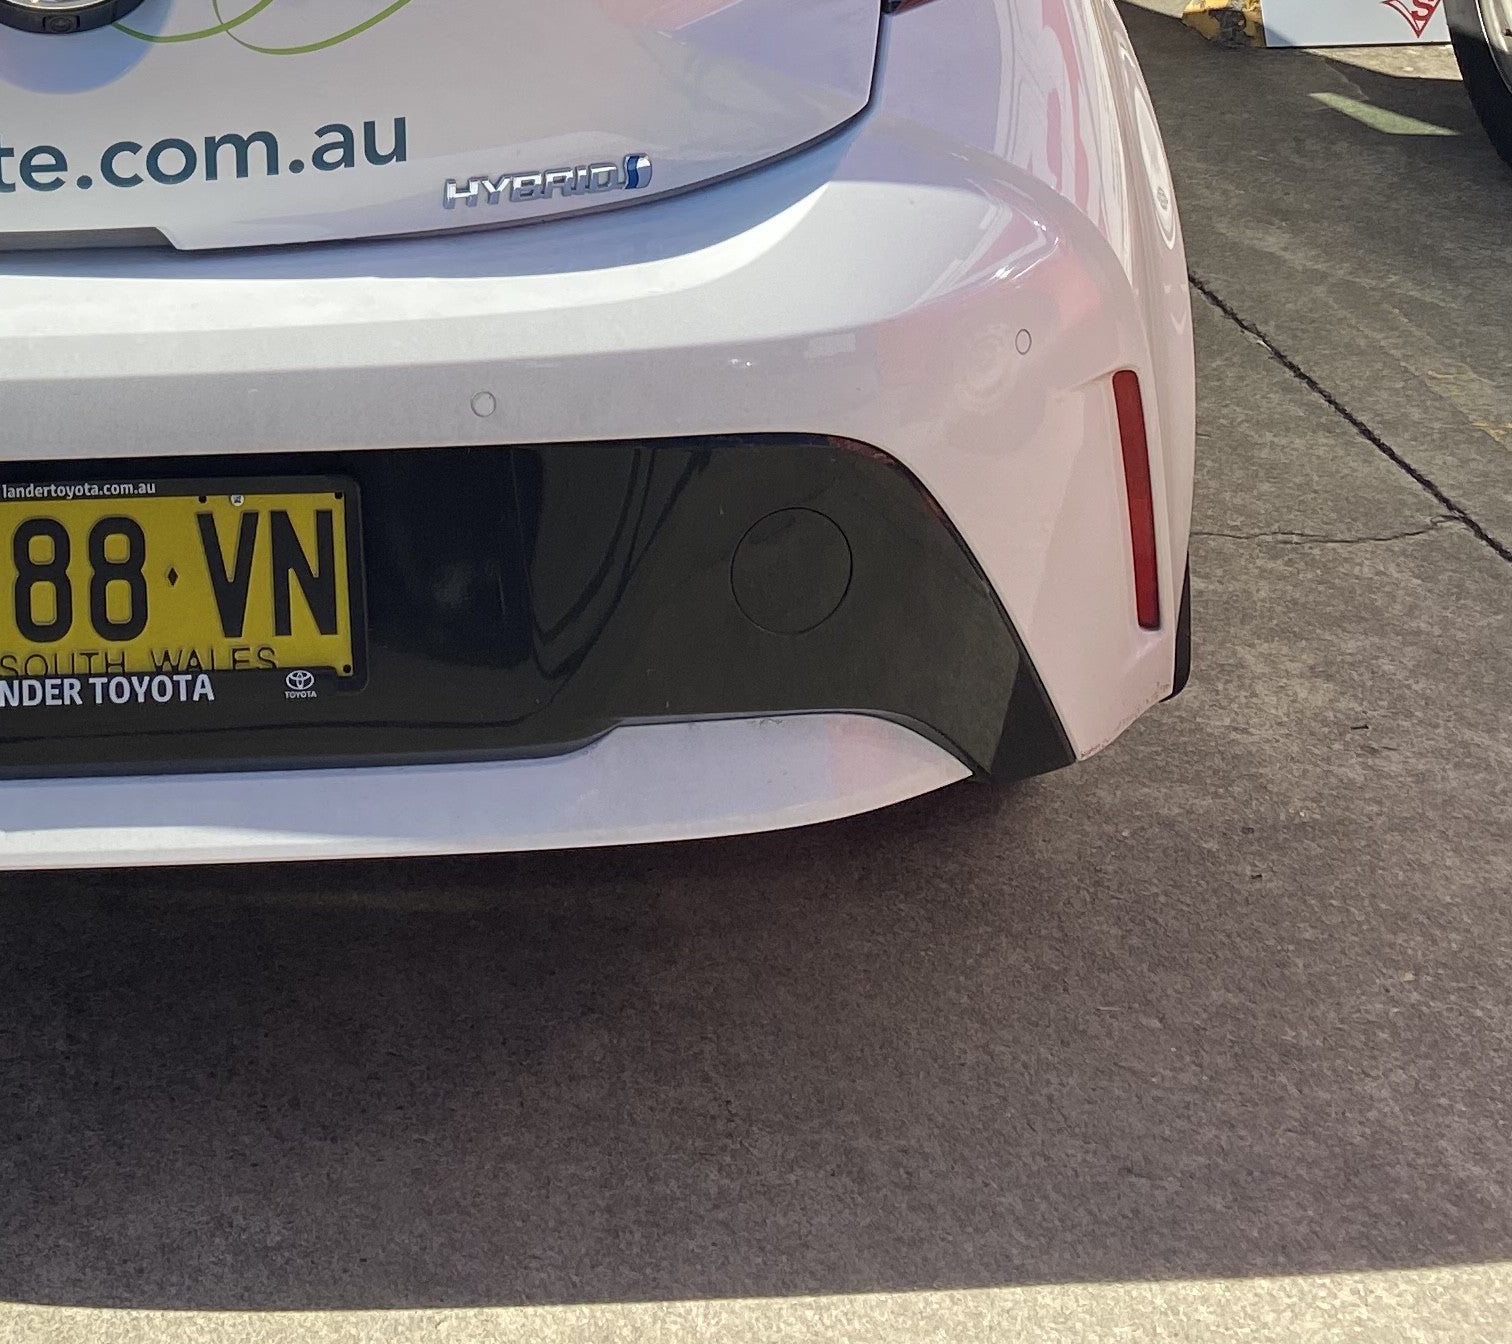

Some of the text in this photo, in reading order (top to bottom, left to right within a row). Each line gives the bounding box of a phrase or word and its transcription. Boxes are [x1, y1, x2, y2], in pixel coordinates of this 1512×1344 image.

[443, 162, 617, 210] HYBRID
[2, 480, 156, 499] landertoyota.com.au
[12, 517, 148, 643] 88
[197, 509, 339, 638] VN
[0, 651, 127, 676] SOUTH
[150, 646, 279, 672] WALES
[88, 674, 215, 703] TOYOTA
[284, 691, 317, 699] TOYOTA
